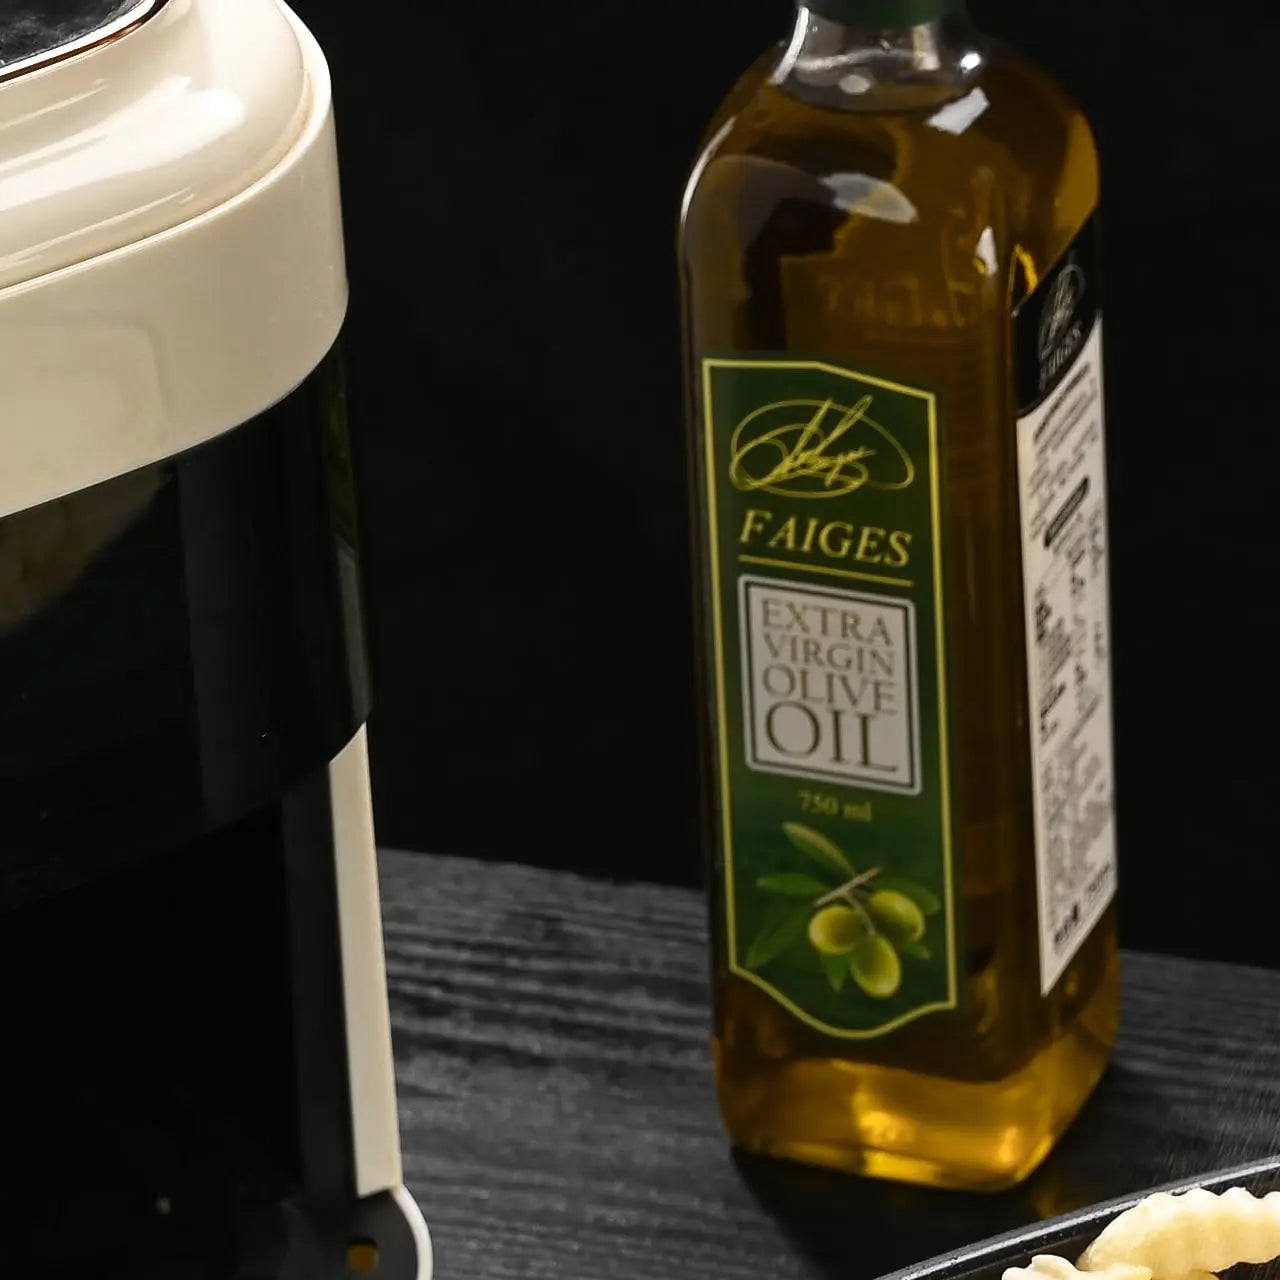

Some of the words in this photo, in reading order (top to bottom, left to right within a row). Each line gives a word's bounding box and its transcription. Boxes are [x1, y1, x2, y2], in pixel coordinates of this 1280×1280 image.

[739, 508, 912, 567] FAIGES
[761, 600, 896, 646] EXTRA
[763, 632, 895, 676] VIRGIN
[762, 663, 898, 716] OLIVE
[766, 700, 898, 773] OIL
[798, 789, 839, 816] 750
